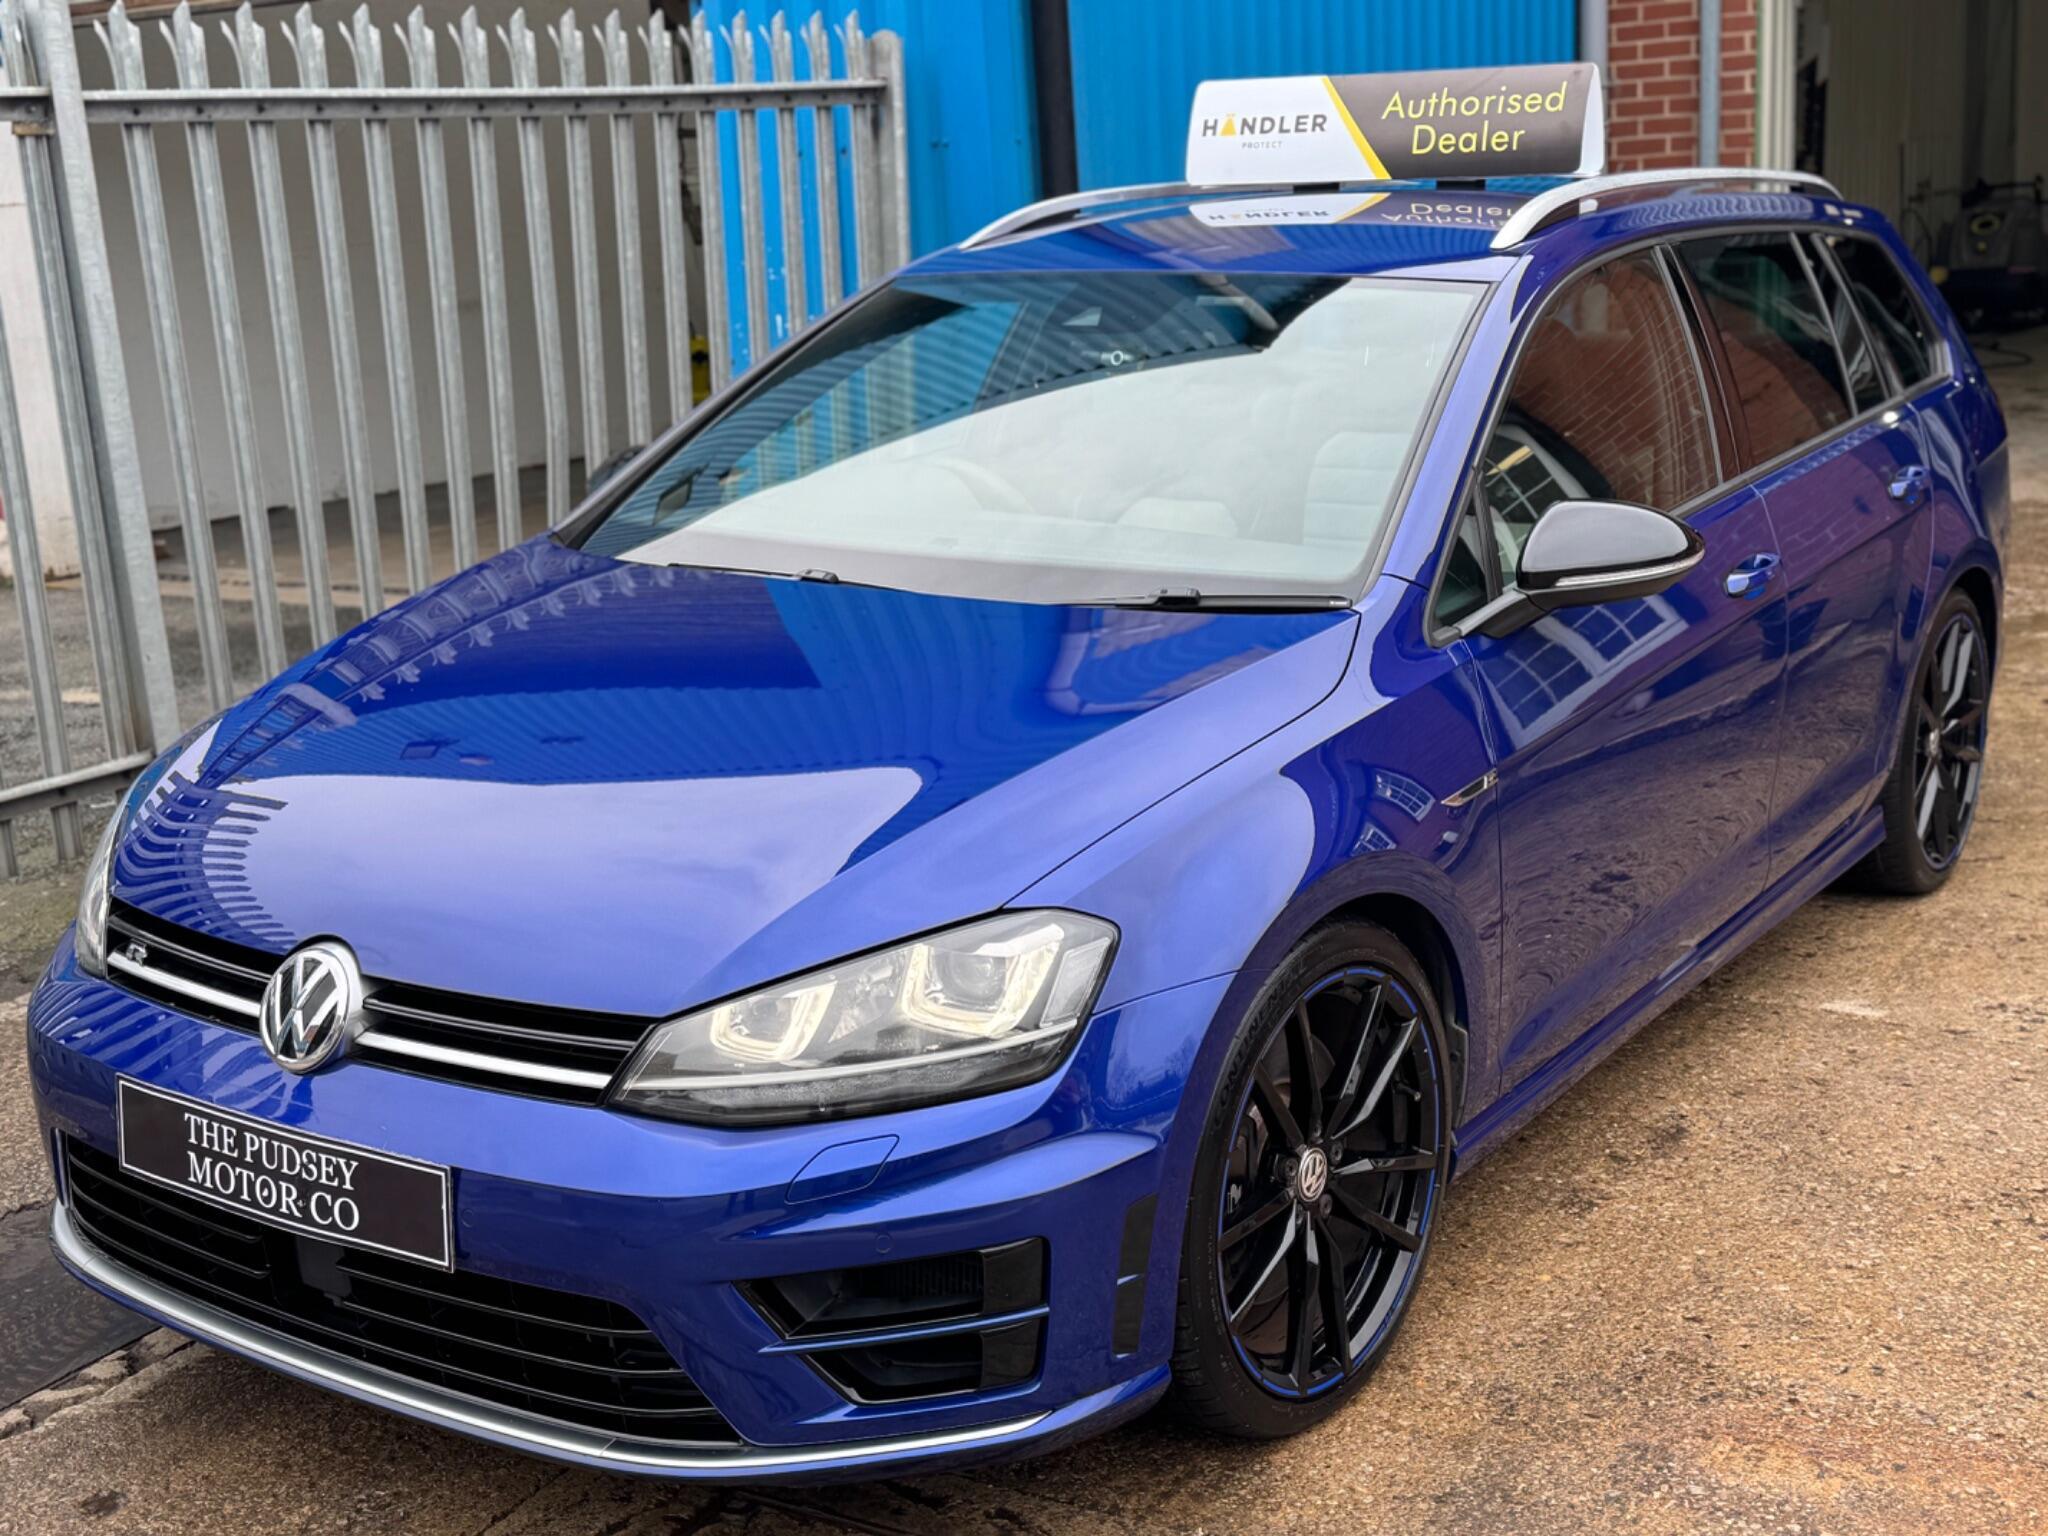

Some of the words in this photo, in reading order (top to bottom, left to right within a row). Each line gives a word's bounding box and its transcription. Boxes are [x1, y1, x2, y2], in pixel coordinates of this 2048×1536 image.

[1381, 81, 1568, 120] Authorised
[1241, 141, 1282, 149] PROTECT
[1412, 120, 1526, 155] Dealer
[184, 1112, 238, 1158] THE
[243, 1131, 359, 1190] PUDSEY
[187, 1151, 302, 1217] MOTOR
[310, 1191, 360, 1231] CO
